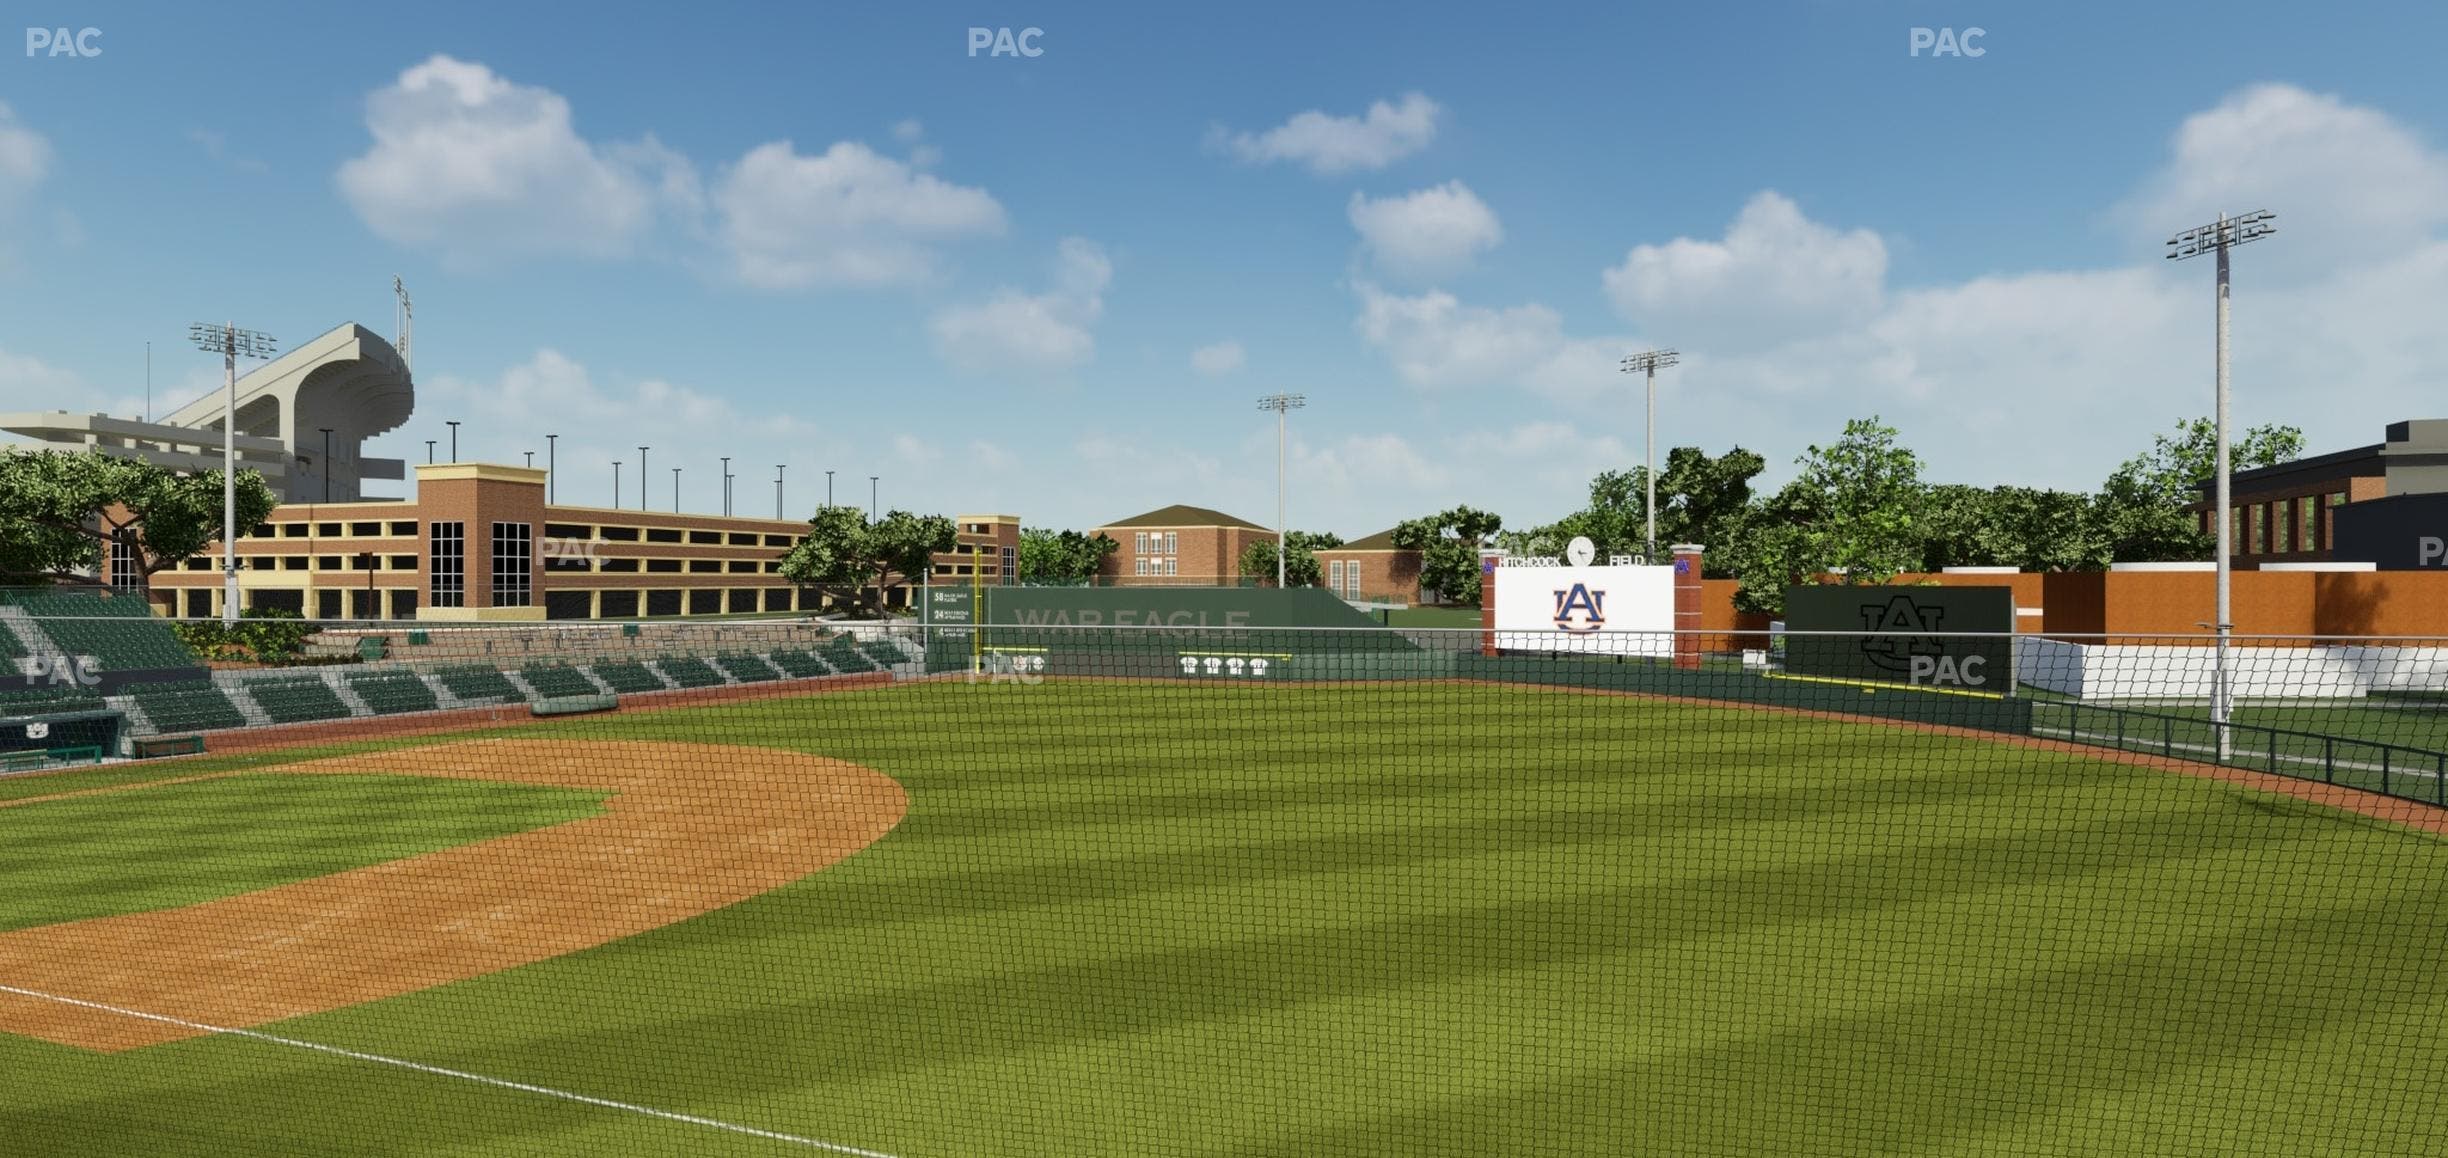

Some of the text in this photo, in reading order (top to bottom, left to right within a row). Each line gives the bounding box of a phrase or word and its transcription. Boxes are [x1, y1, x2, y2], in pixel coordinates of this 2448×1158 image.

[1498, 555, 1644, 567] HITCHCOCK FIELD
[1015, 609, 1250, 639] WAR EAGLE
